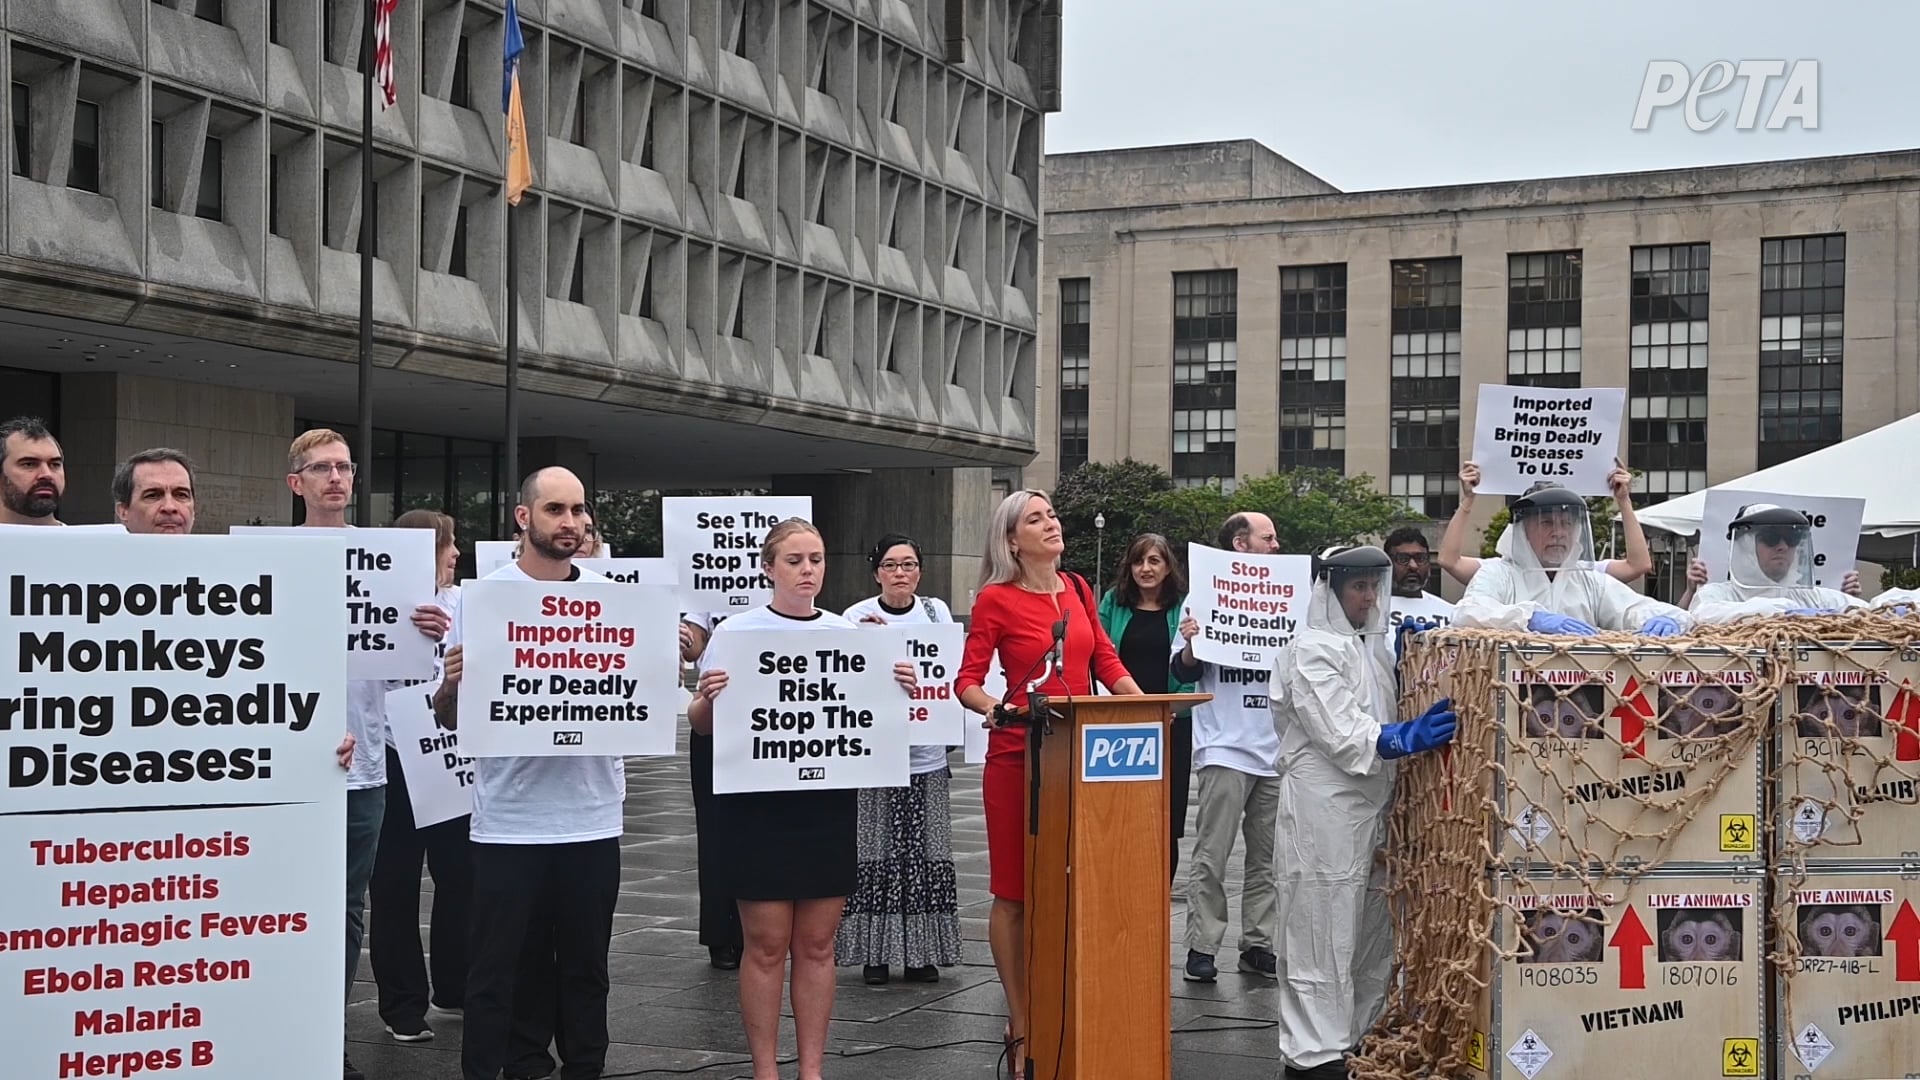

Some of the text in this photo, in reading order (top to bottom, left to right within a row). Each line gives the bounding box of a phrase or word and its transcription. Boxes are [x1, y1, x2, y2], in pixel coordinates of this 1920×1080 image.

[1513, 395, 1592, 412] Imported
[1514, 412, 1587, 429] Monkeys
[1495, 428, 1602, 445] Bring Deadly
[1511, 445, 1583, 459] Diseases
[1517, 462, 1574, 475] To U.S.
[697, 511, 779, 529] See The
[713, 532, 764, 549] Risk.
[692, 552, 741, 573] Stop
[1231, 562, 1270, 580] Stop
[1213, 575, 1294, 598] Importing
[10, 575, 272, 624] Imported
[541, 595, 601, 621] Stop
[1217, 594, 1288, 615] Monkeys
[346, 602, 398, 624] The
[1211, 609, 1297, 633] For Deadly
[347, 630, 395, 651] rts.
[508, 621, 635, 648] Importing
[1205, 625, 1294, 647] Experimen
[19, 629, 265, 679] Monkeys
[907, 639, 939, 657] he
[515, 648, 626, 673] Monkeys
[758, 649, 866, 675] See The
[919, 661, 946, 679] To
[502, 674, 638, 699] For Deadly
[1512, 670, 1614, 684] LIE ANIMS
[1652, 671, 1682, 684] IVE
[779, 677, 846, 702] Risk.
[910, 683, 950, 700] and
[0, 683, 320, 736] ring Deadly
[490, 700, 649, 725] Experiments
[750, 705, 873, 734] Stop The
[419, 733, 457, 755] Brin
[752, 734, 871, 763] Imports.
[9, 743, 271, 788] Diseases:
[30, 831, 250, 866] Tuberculosis
[61, 874, 219, 909] Hepatitis
[1648, 893, 1751, 907] LIVE ANIMALS
[1799, 889, 1892, 904] IVE ANIMALS
[0, 911, 308, 951] morrhagic Fevers
[24, 958, 250, 995] Ebola Reston
[1520, 966, 1598, 987] 1908035
[1662, 965, 1738, 987] 1807016
[74, 1002, 202, 1037] Malaria
[1581, 1000, 1684, 1033] VIETNAM
[1838, 995, 1920, 1026] PHILIPP
[59, 1040, 214, 1079] Herpes B
